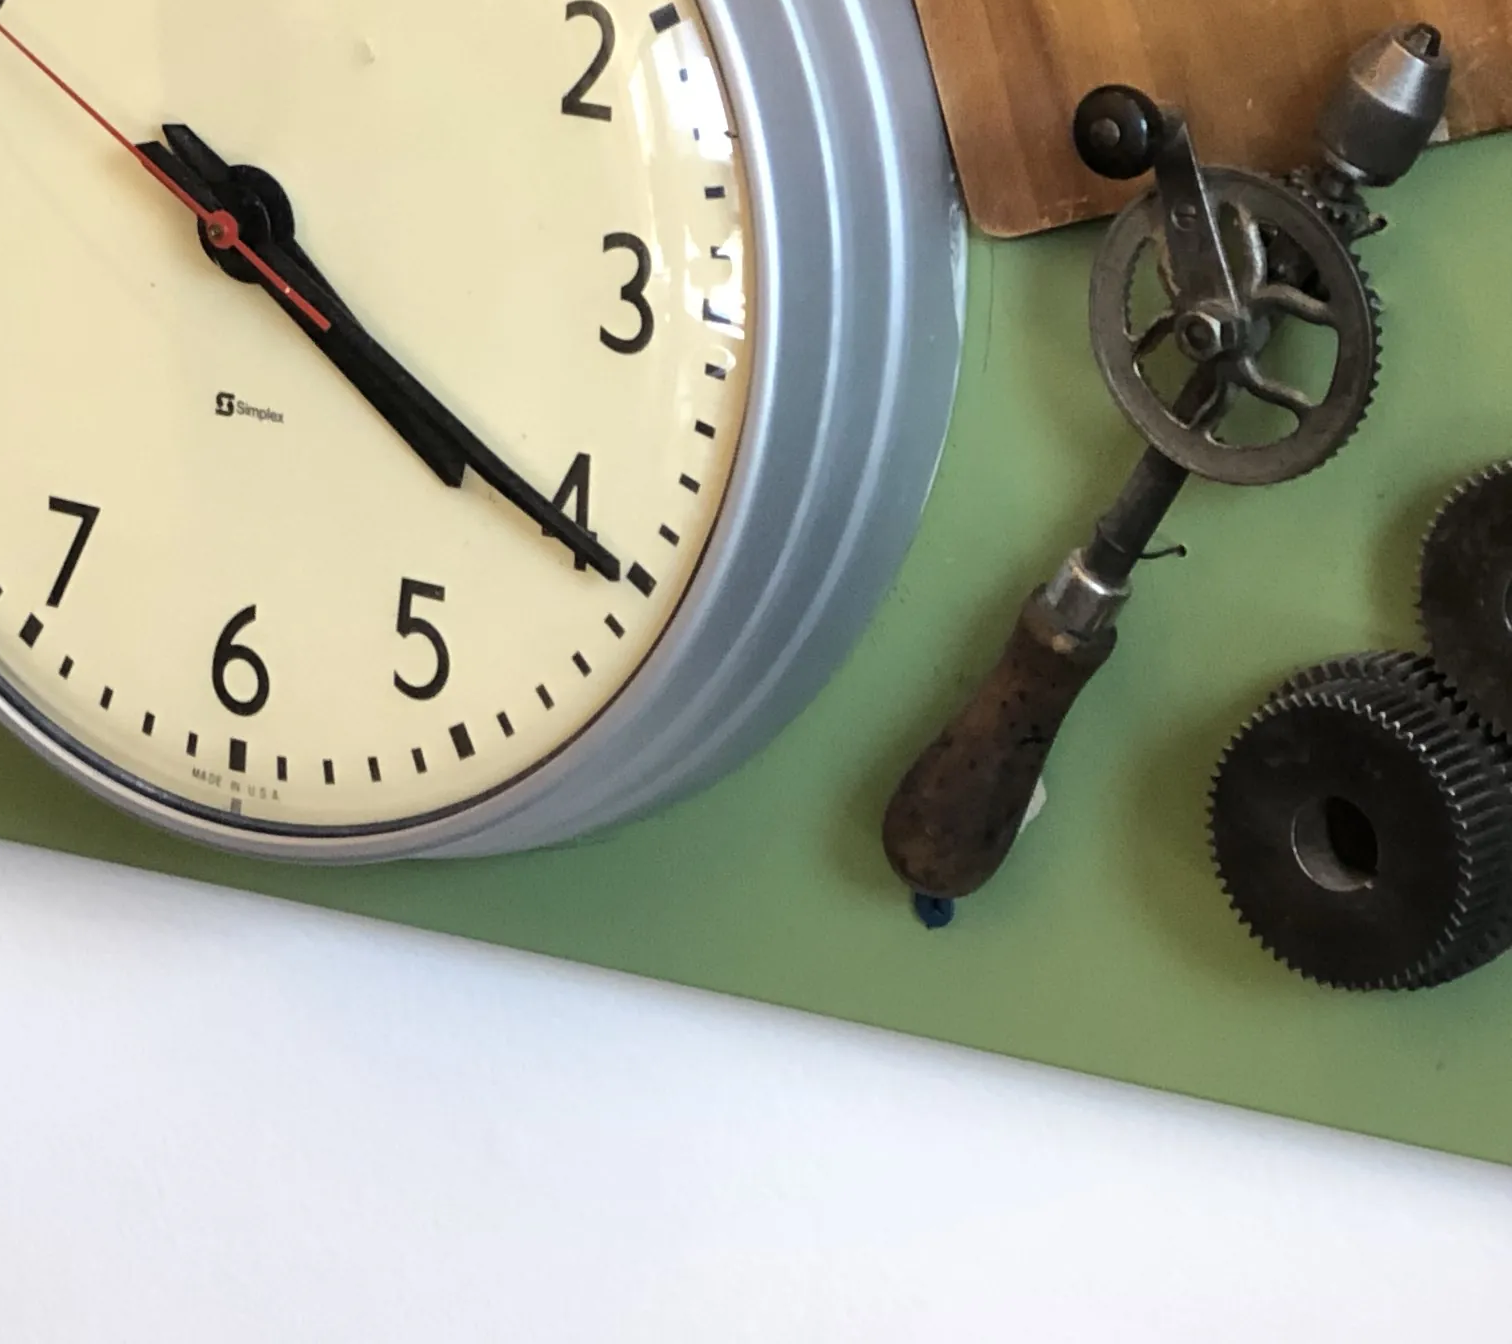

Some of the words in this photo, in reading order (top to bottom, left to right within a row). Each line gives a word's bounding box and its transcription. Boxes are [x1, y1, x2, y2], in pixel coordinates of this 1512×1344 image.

[561, 0, 615, 122] 2
[599, 232, 654, 354] 3
[236, 399, 285, 423] Simplex
[46, 496, 100, 609] 7
[541, 453, 599, 570] 4
[211, 604, 270, 717] 6
[394, 577, 450, 701] 5
[191, 766, 223, 788] MADE
[230, 779, 241, 793] IN
